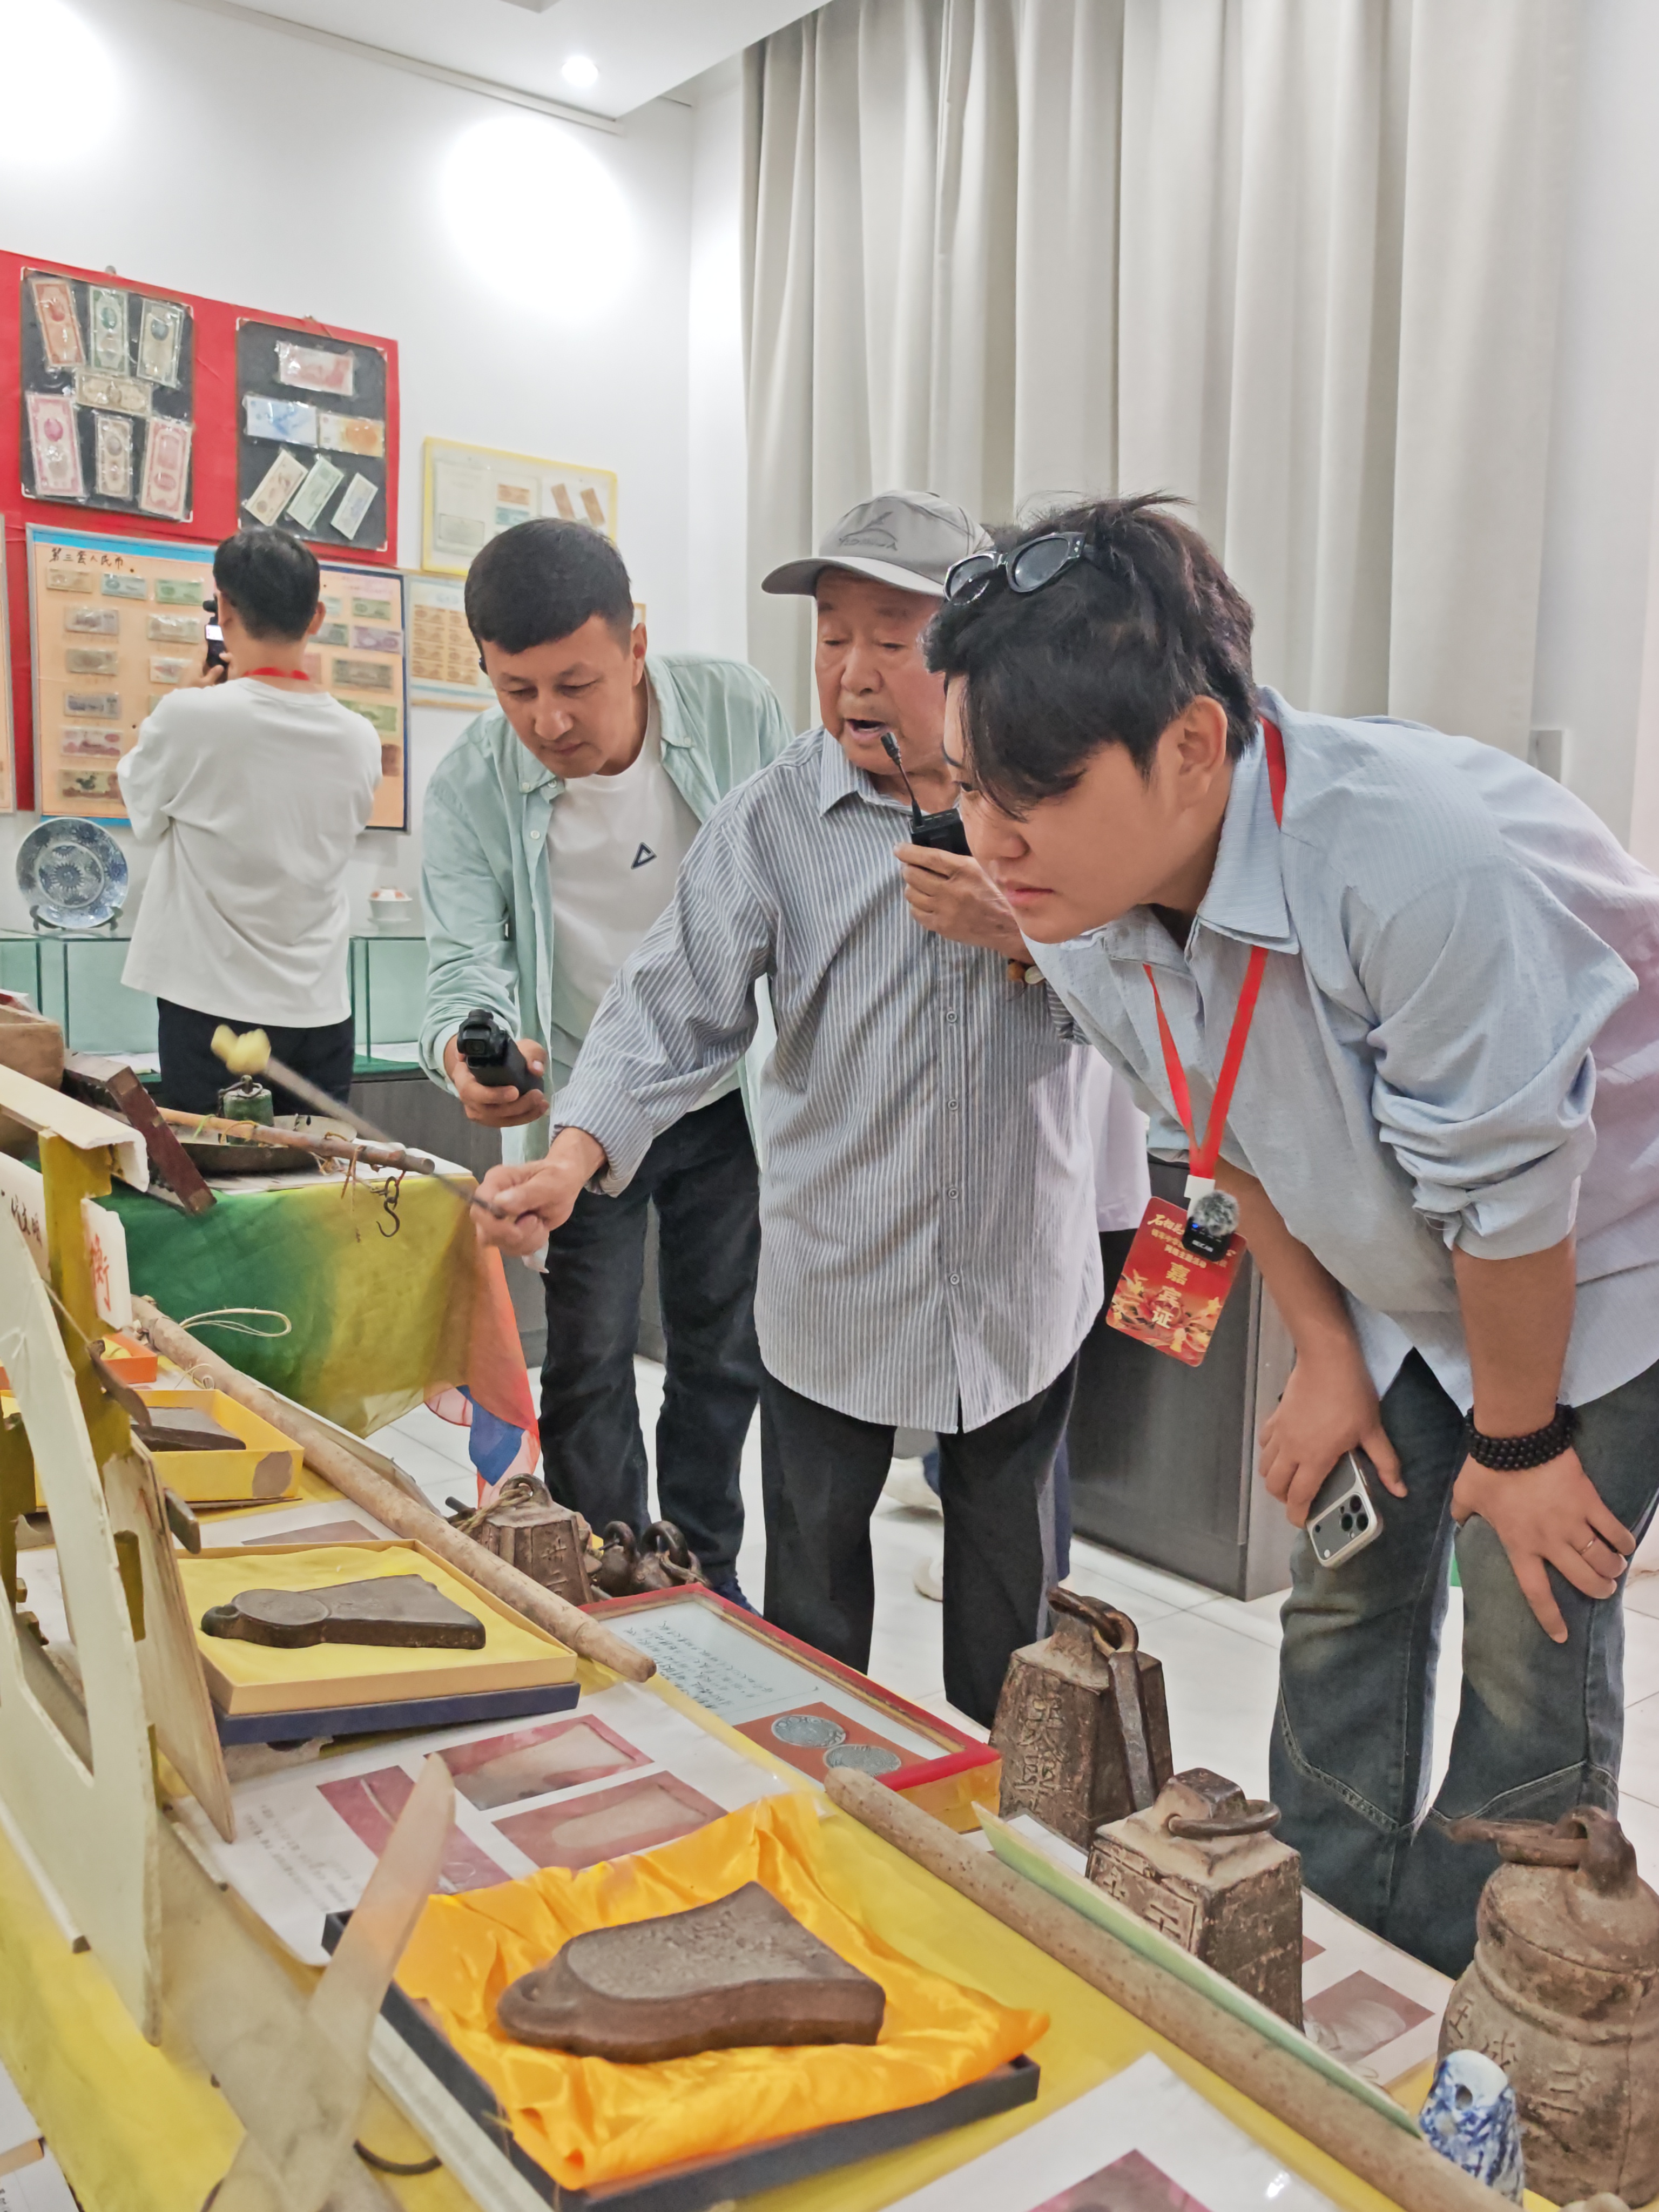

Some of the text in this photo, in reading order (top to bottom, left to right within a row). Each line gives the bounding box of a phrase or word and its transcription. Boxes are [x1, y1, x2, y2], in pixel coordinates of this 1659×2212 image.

[49, 548, 124, 570] 第三套人民币
[1152, 1262, 1191, 1329] 嘉宾证
